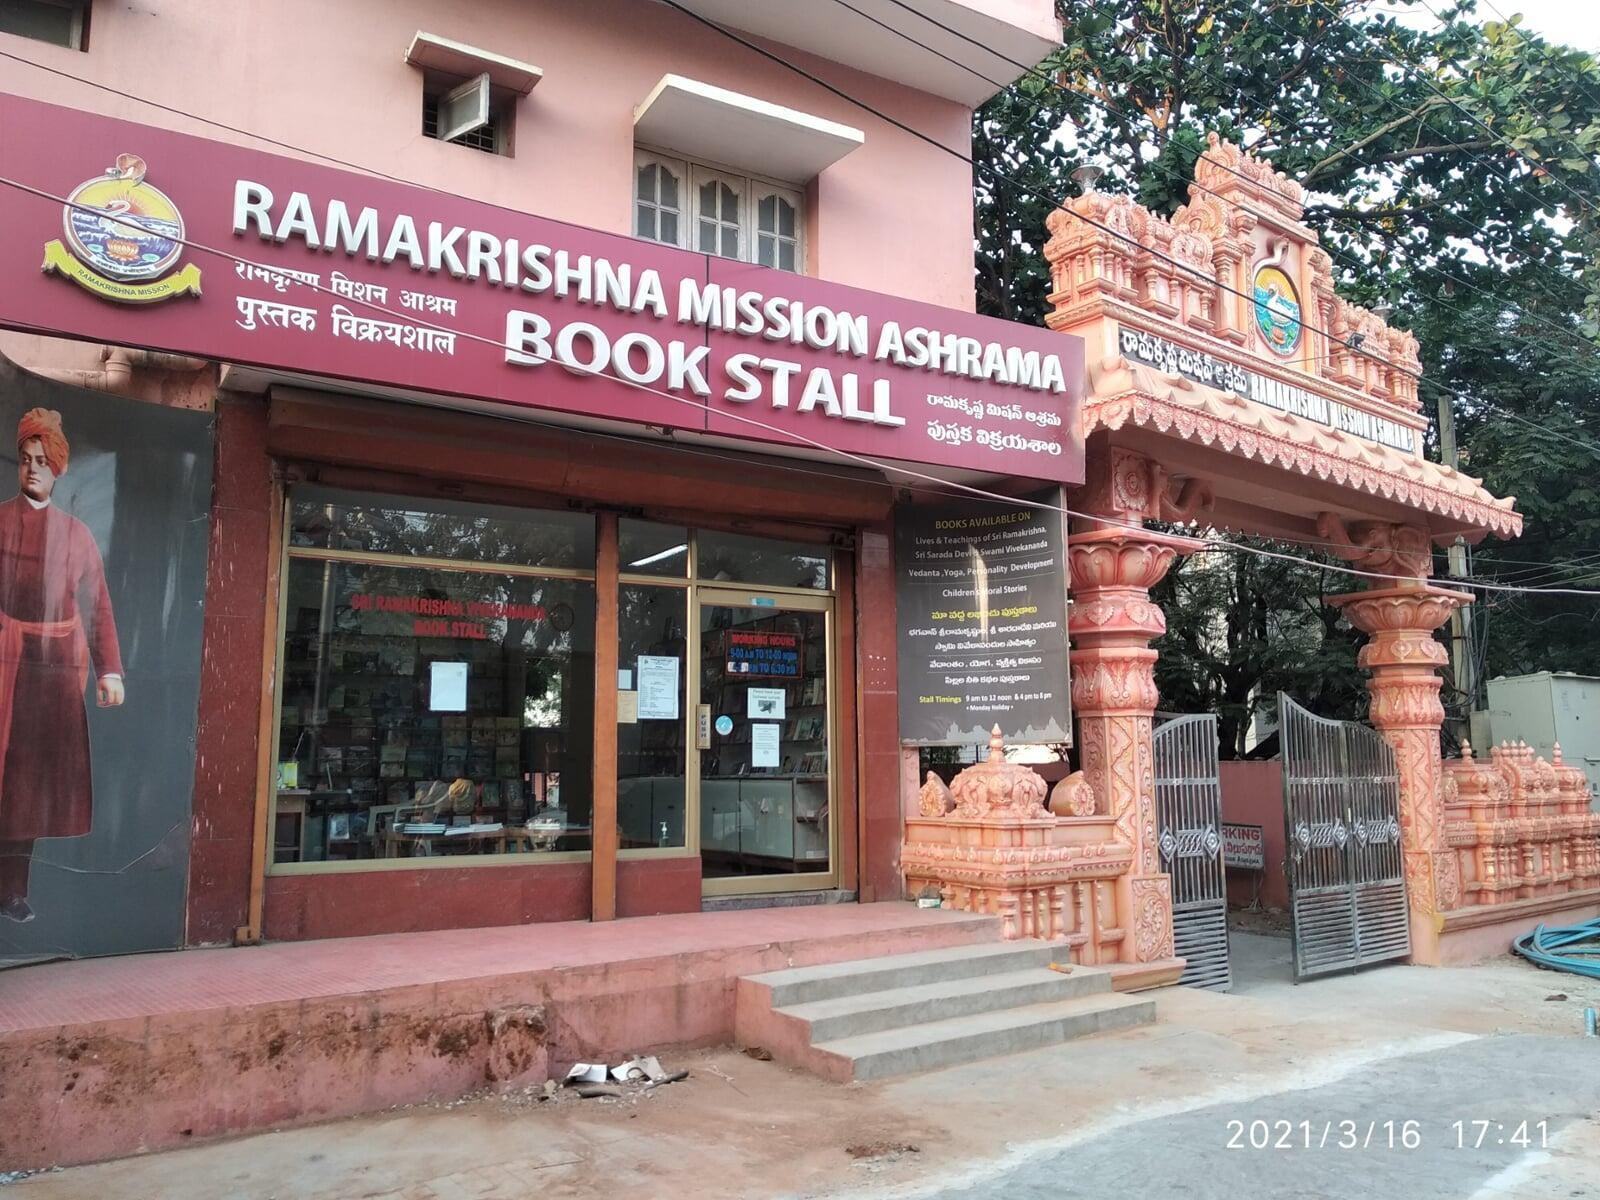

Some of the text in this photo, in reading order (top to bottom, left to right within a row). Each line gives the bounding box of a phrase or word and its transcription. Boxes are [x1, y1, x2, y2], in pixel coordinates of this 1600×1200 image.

[77, 269, 170, 296] RAMAKRISHNA MISSION
[233, 179, 1067, 394] RAMAKRISHNA MISSION ASHRAMA
[235, 260, 457, 316] रामकृष्ण मिशन आश्रम
[236, 296, 456, 355] पुस्तक विक्रयशाल
[504, 308, 906, 427] BOOK STALL
[927, 394, 1061, 427] రామకృష్ణ మిషన్ ఆశ్రమ
[1251, 372, 1329, 425] RAMAKRISHNA
[1330, 401, 1370, 440] MISSION
[927, 419, 1062, 455] పుస్తక విక్రయశాల
[936, 512, 1031, 529] BOOKS AVAILABLE ON
[915, 526, 1047, 545] Lives & Teachings of Sri Ramakrishna,
[915, 550, 925, 559] Sri
[926, 550, 953, 559] Sarada
[955, 549, 971, 558] Devi
[981, 546, 1004, 556] Swami
[1005, 540, 1048, 554] Vivekananda
[909, 568, 940, 577] Vedanta
[967, 565, 1008, 576] Peonality
[1010, 558, 1054, 572] Development
[981, 586, 1002, 596] oral
[1003, 584, 1027, 594] Stories
[452, 622, 487, 639] STALL
[935, 695, 962, 704] Timings
